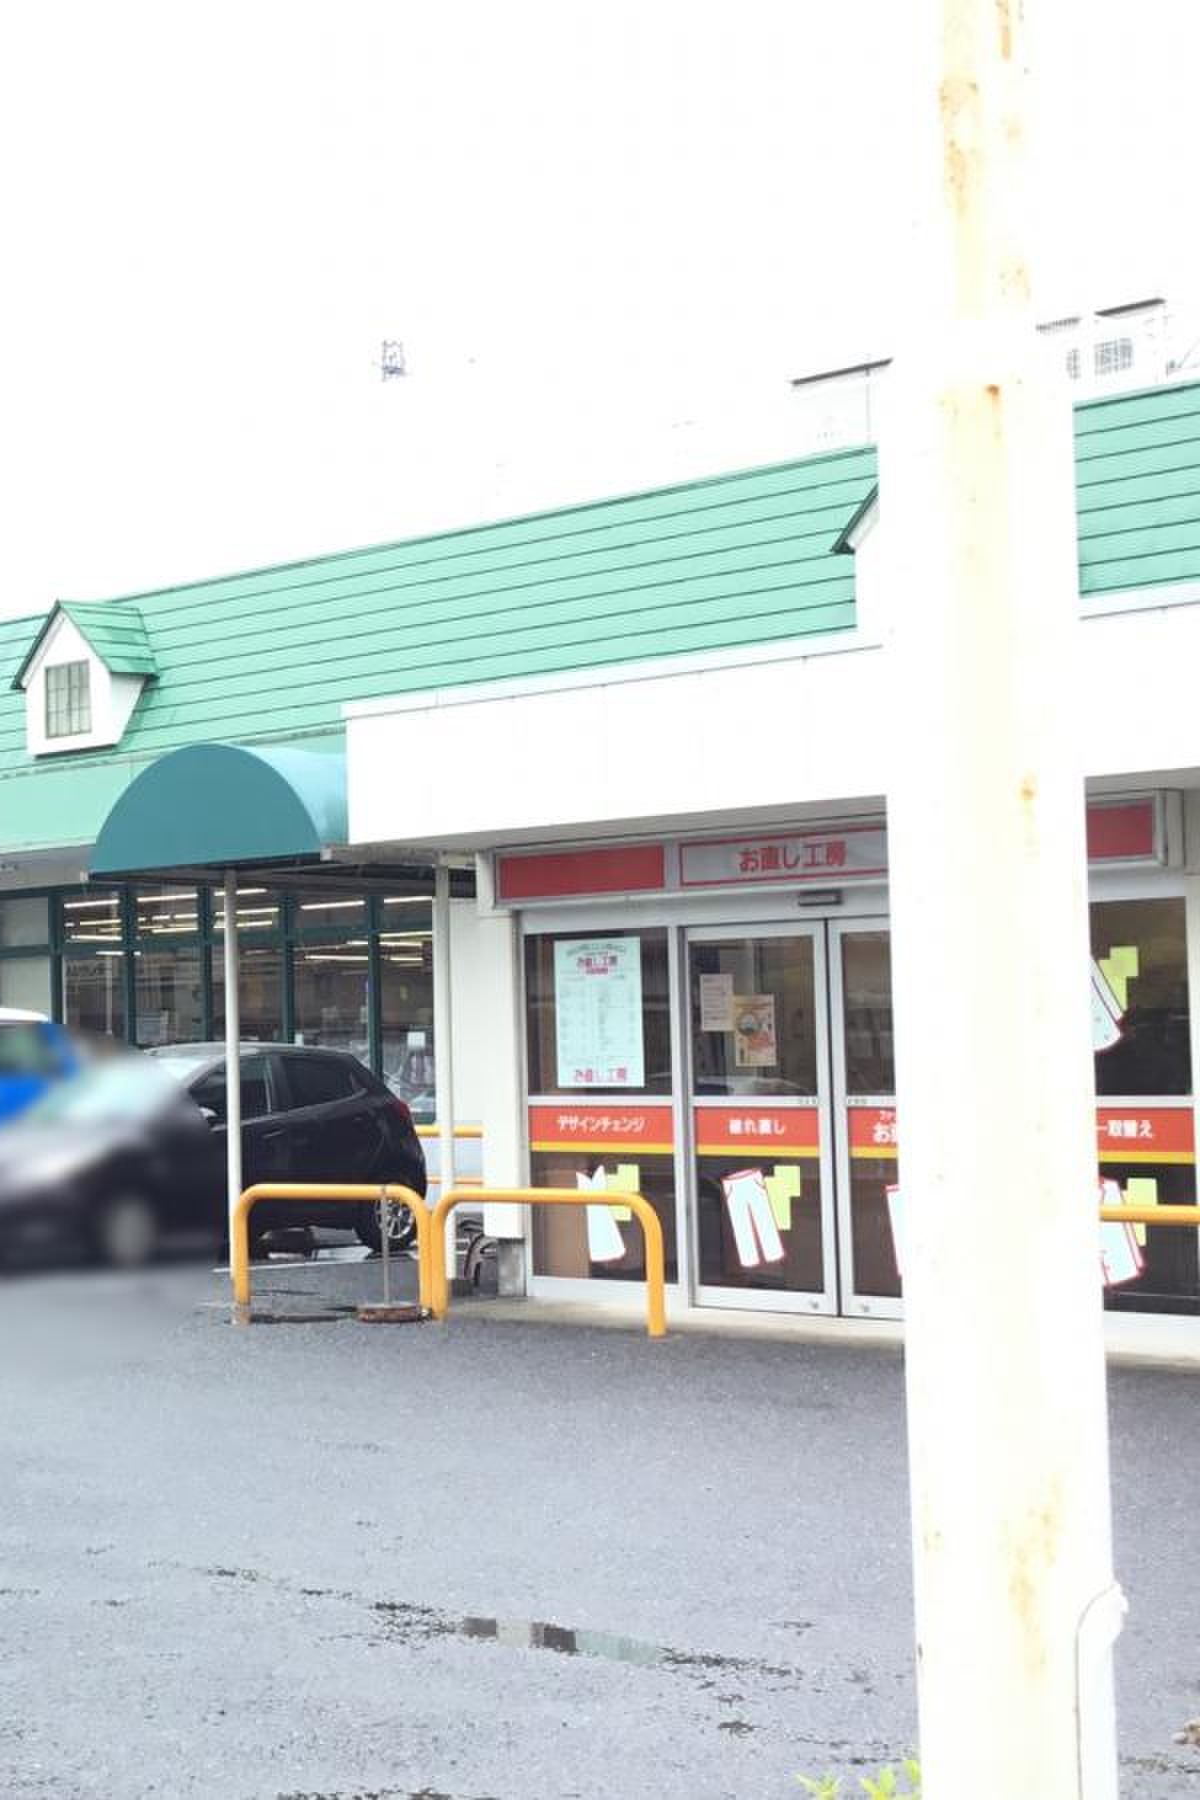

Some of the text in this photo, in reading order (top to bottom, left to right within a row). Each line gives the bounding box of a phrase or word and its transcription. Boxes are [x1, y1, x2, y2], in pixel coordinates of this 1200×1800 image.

[738, 841, 847, 872] お直し工房
